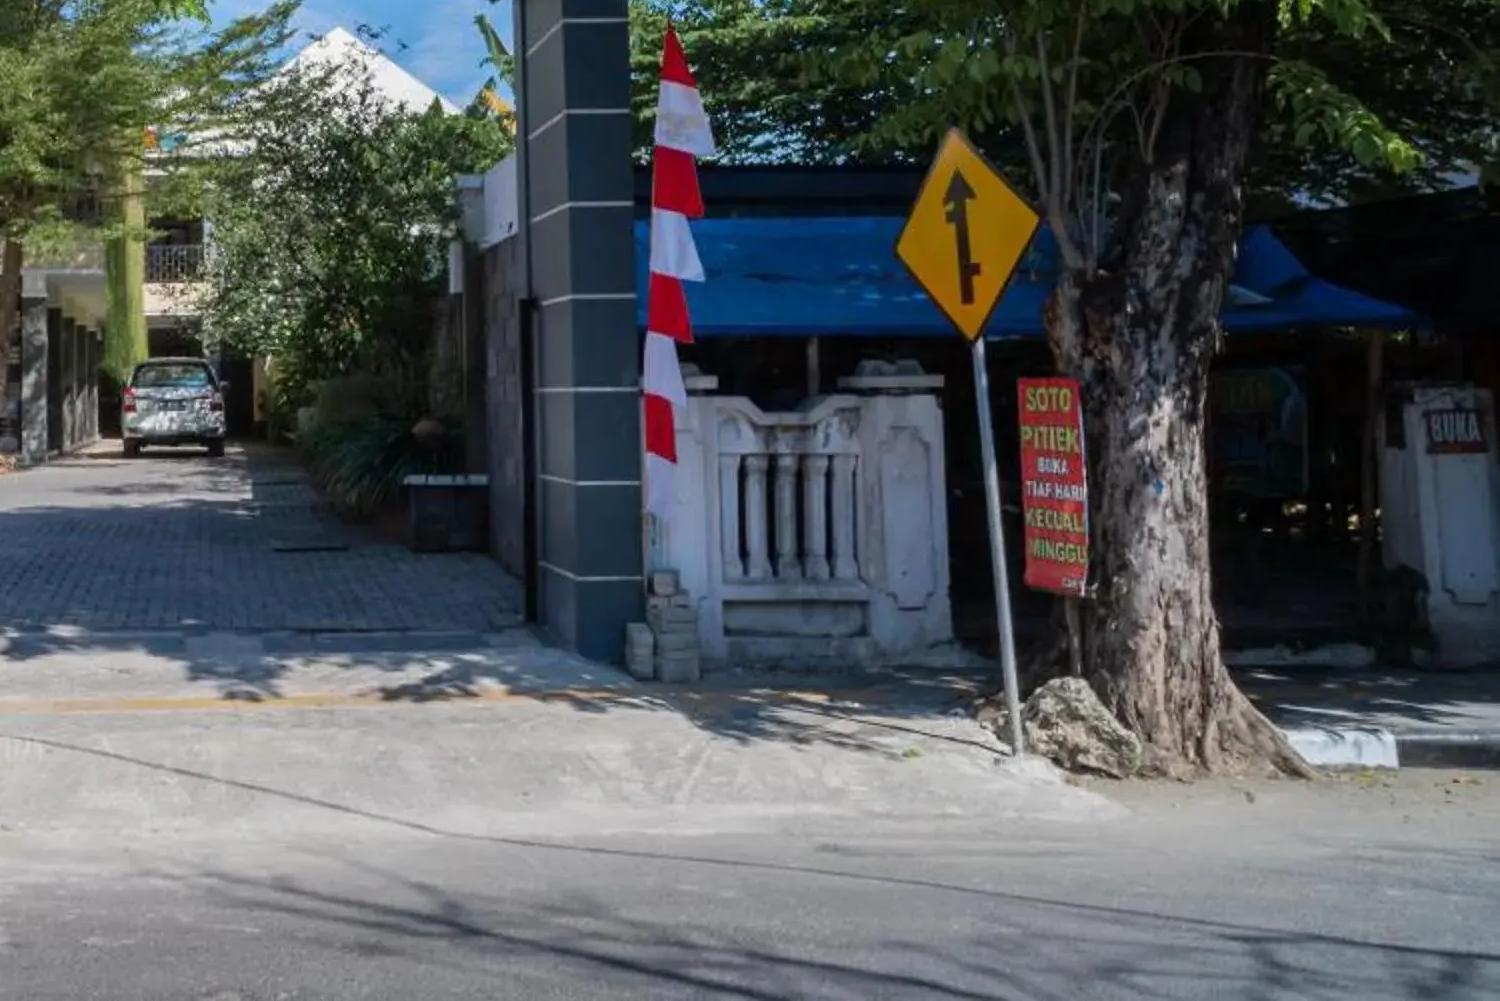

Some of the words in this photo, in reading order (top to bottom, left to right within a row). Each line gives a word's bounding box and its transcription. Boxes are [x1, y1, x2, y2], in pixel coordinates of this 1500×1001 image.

[1026, 387, 1072, 412] SOTO
[1430, 410, 1482, 443] BUKA
[1021, 426, 1081, 454] PITIEK
[1037, 456, 1069, 475] BUKA
[1025, 479, 1051, 498] TIAP
[1025, 506, 1088, 534] KECUAL
